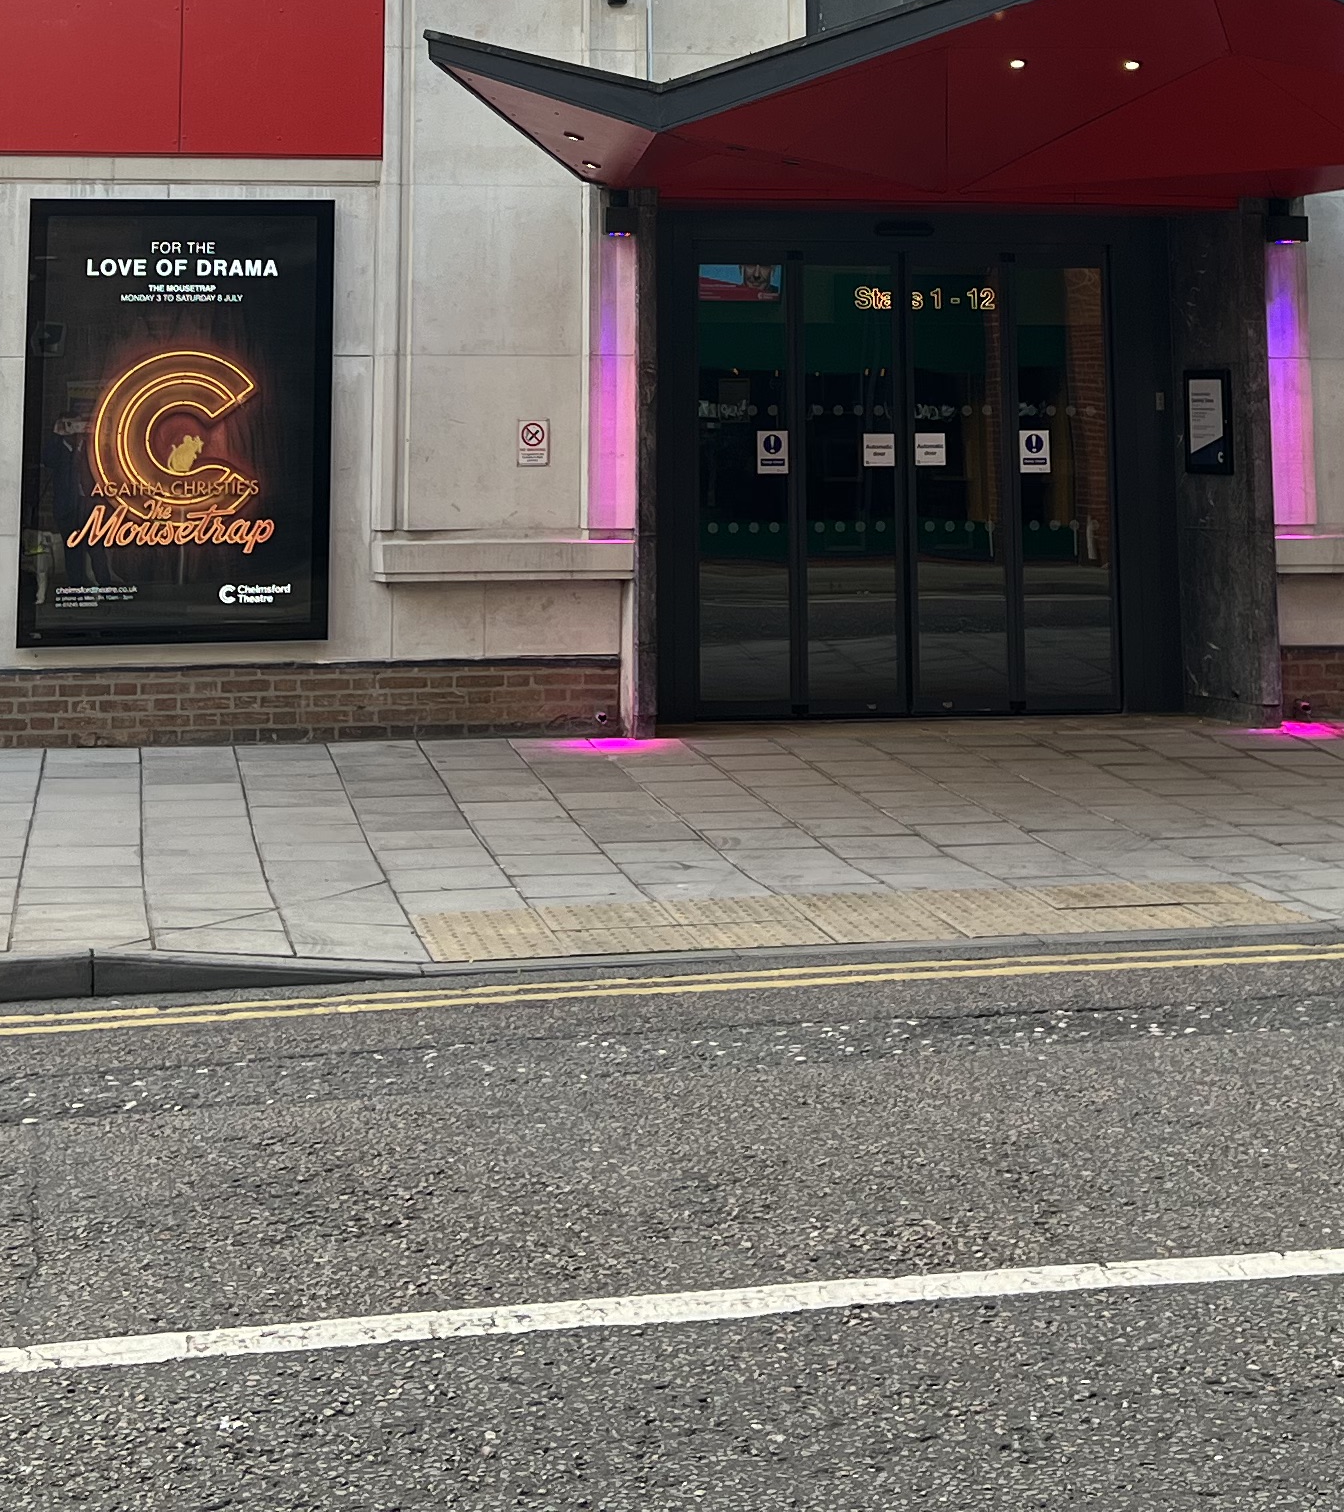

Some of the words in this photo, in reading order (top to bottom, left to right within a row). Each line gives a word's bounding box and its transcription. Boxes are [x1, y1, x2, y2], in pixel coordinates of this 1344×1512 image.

[150, 241, 182, 254] FOR
[186, 241, 216, 254] THE
[86, 258, 147, 277] LOVE
[155, 259, 188, 277] OF
[196, 259, 278, 277] DRAMA
[148, 284, 164, 292] THE
[166, 284, 216, 292] MOUSETRAP
[120, 294, 154, 302] MONDAY
[156, 294, 162, 302] 3
[163, 294, 174, 302] TO
[175, 294, 215, 302] SATURDAY
[224, 294, 244, 302] JULY
[930, 288, 941, 310] 1
[966, 288, 996, 310] 12
[90, 481, 165, 497] AGATHA
[170, 480, 259, 496] CHRISTIE'S
[142, 499, 173, 520] The
[66, 503, 275, 554] Mousetrap
[237, 583, 291, 594] Chelmsford
[237, 594, 274, 603] Theatre
